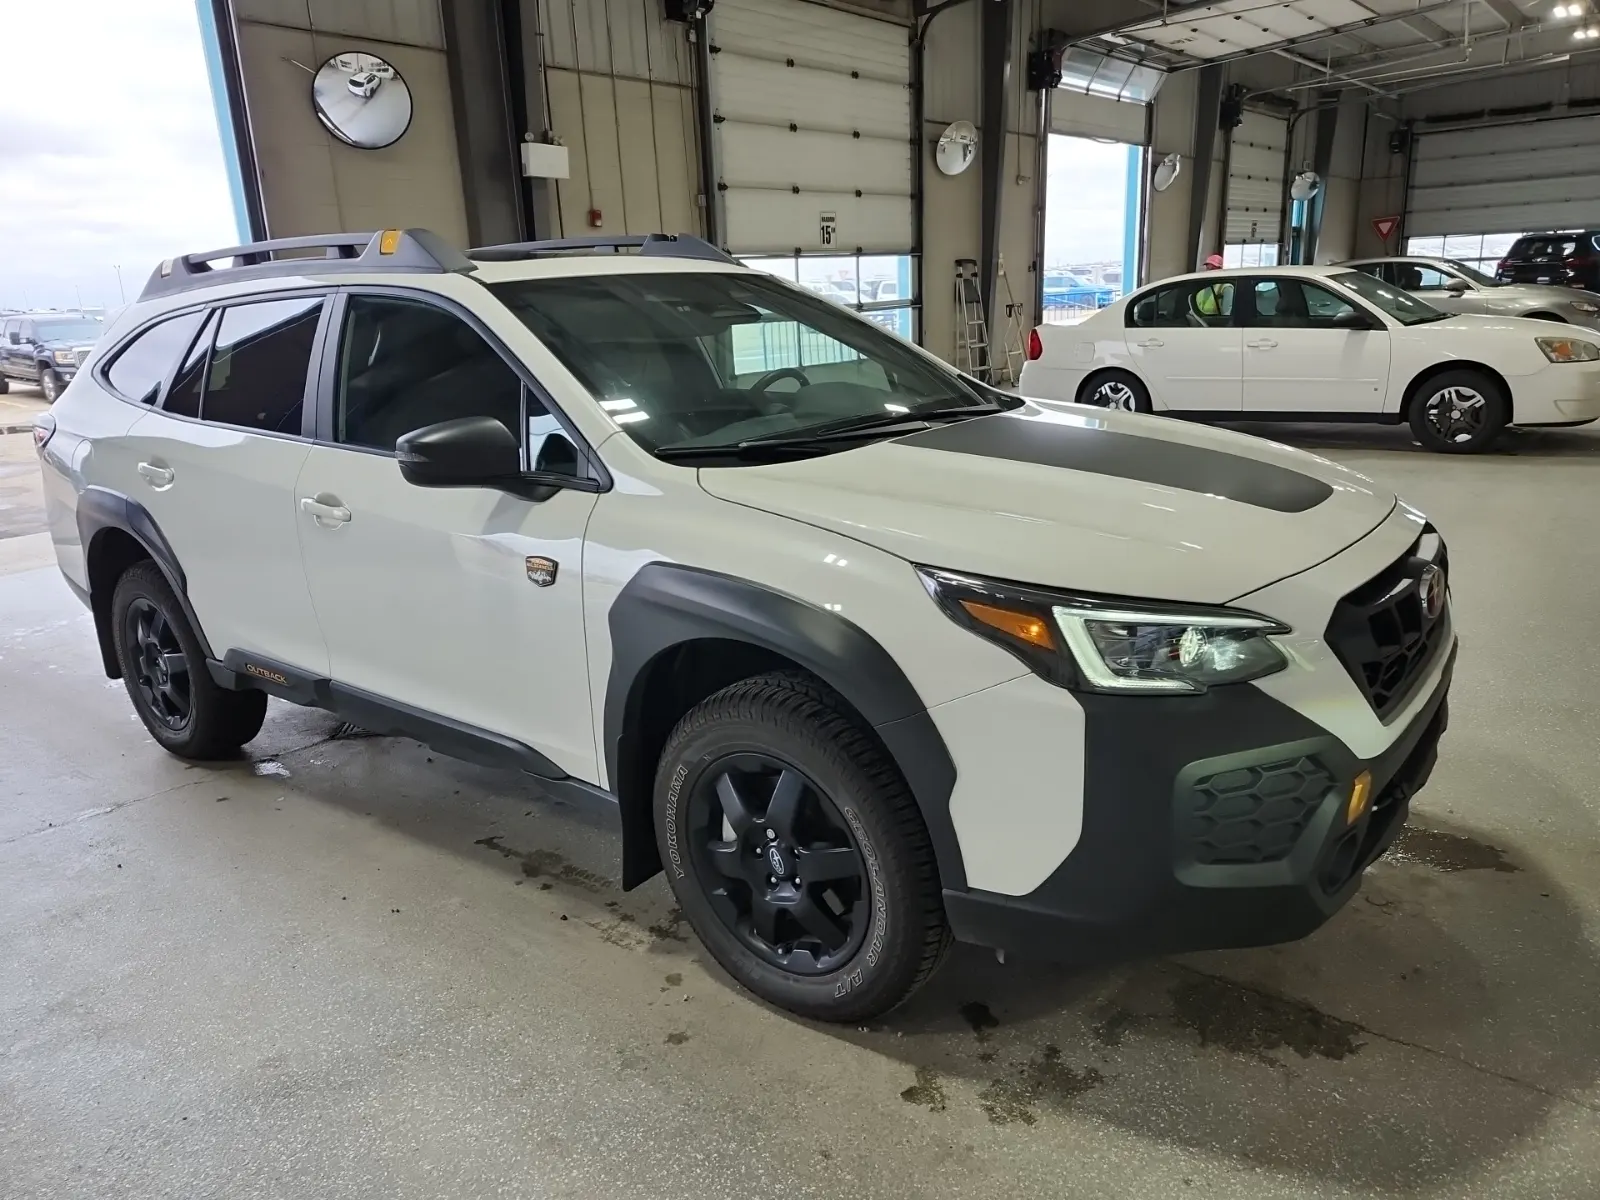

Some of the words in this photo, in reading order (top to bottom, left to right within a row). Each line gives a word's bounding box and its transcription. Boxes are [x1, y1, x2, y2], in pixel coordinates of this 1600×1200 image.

[821, 225, 832, 245] 15
[246, 664, 287, 684] OUTBACK
[666, 764, 688, 879] YOKOHAMA
[844, 806, 888, 967] GEOLANDAR
[834, 969, 864, 998] A/T
